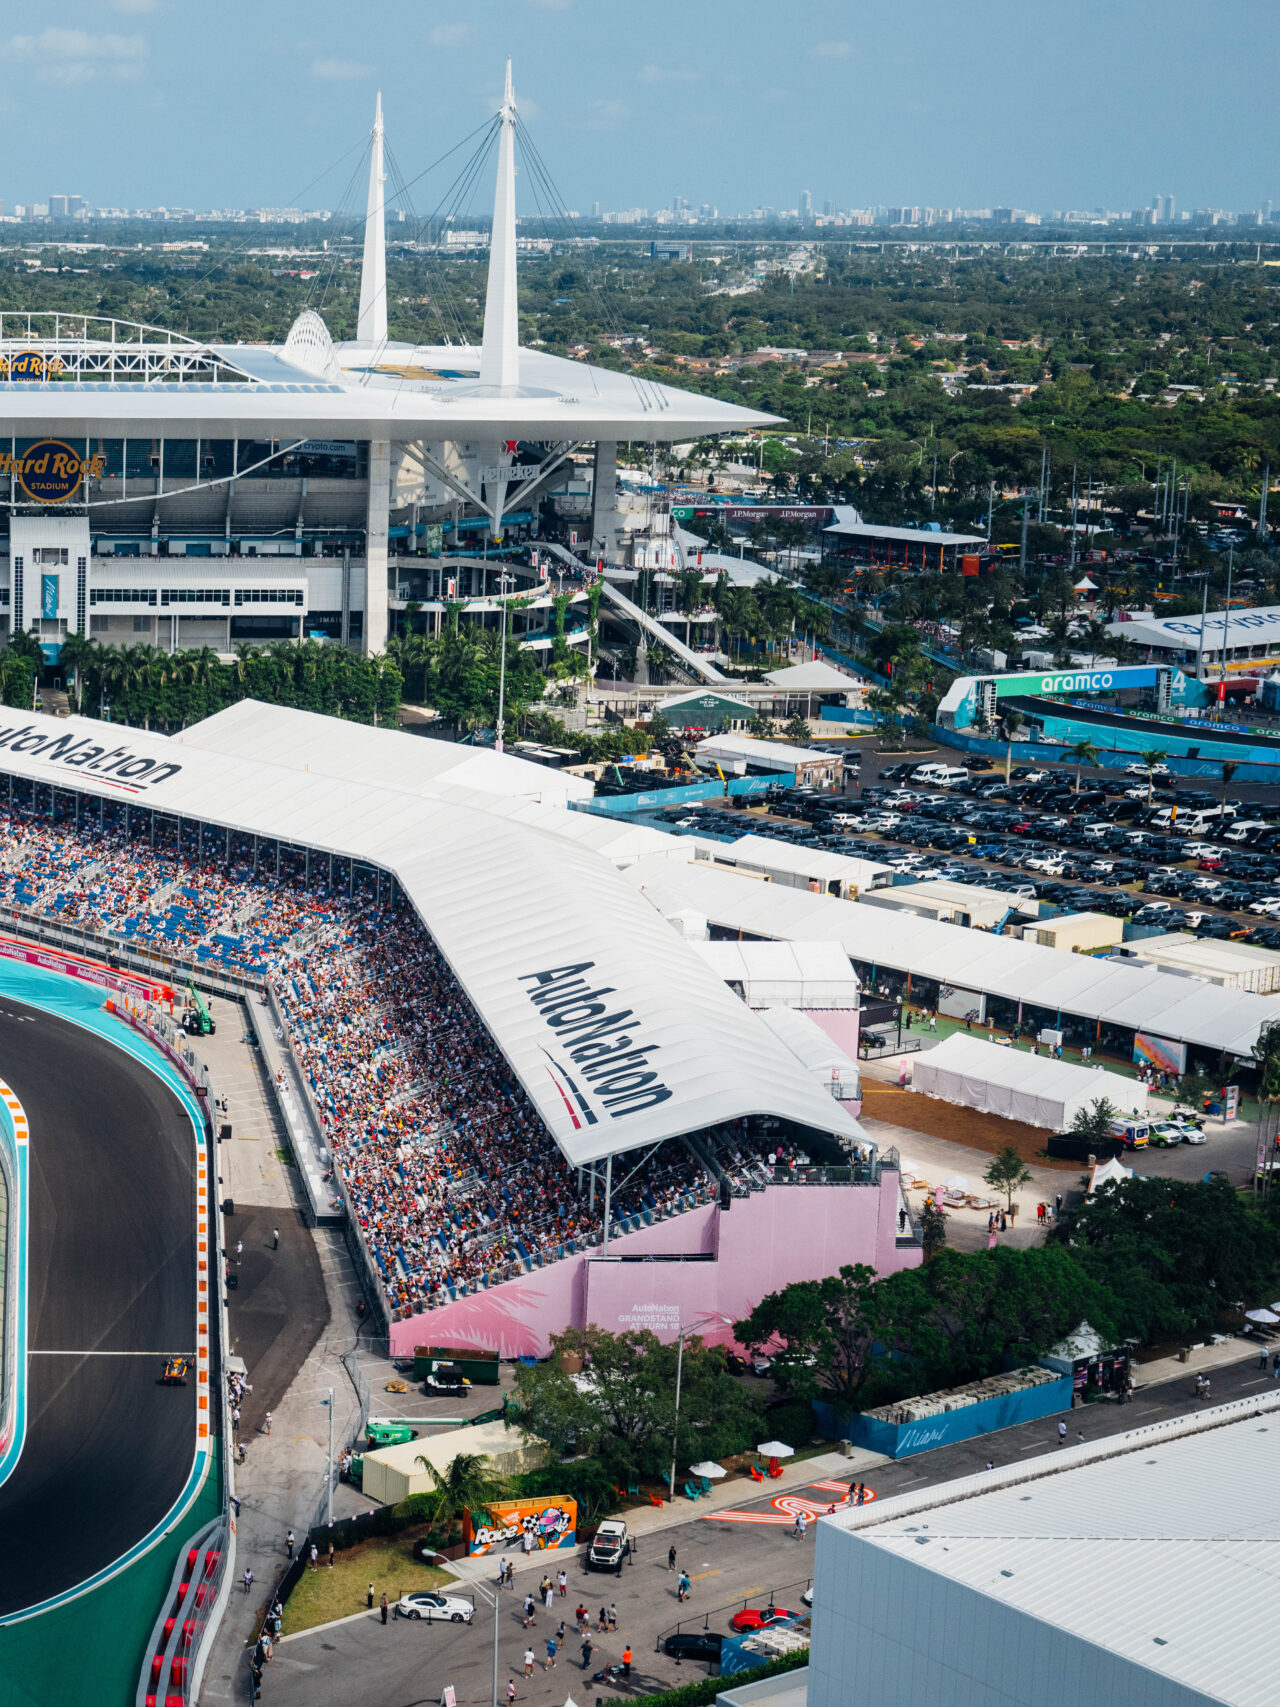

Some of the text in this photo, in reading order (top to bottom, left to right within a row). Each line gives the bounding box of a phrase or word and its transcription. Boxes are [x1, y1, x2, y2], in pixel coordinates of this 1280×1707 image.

[30, 357, 64, 375] Rock
[304, 443, 346, 452] crypto.com
[51, 453, 104, 479] Rock
[30, 482, 69, 490] STADIUM
[780, 510, 817, 519] J.P.Morgan
[674, 670, 692, 684] LEVEL
[1041, 674, 1113, 692] aramco
[1076, 700, 1117, 712] aramco
[1129, 709, 1175, 722] aramco
[1189, 719, 1240, 731] aramco
[37, 956, 67, 971] AutoNation
[77, 968, 106, 984] AutoNation
[517, 961, 673, 1118] AutoNation
[632, 1304, 679, 1312] AutoNation
[474, 1525, 518, 1545] Race
